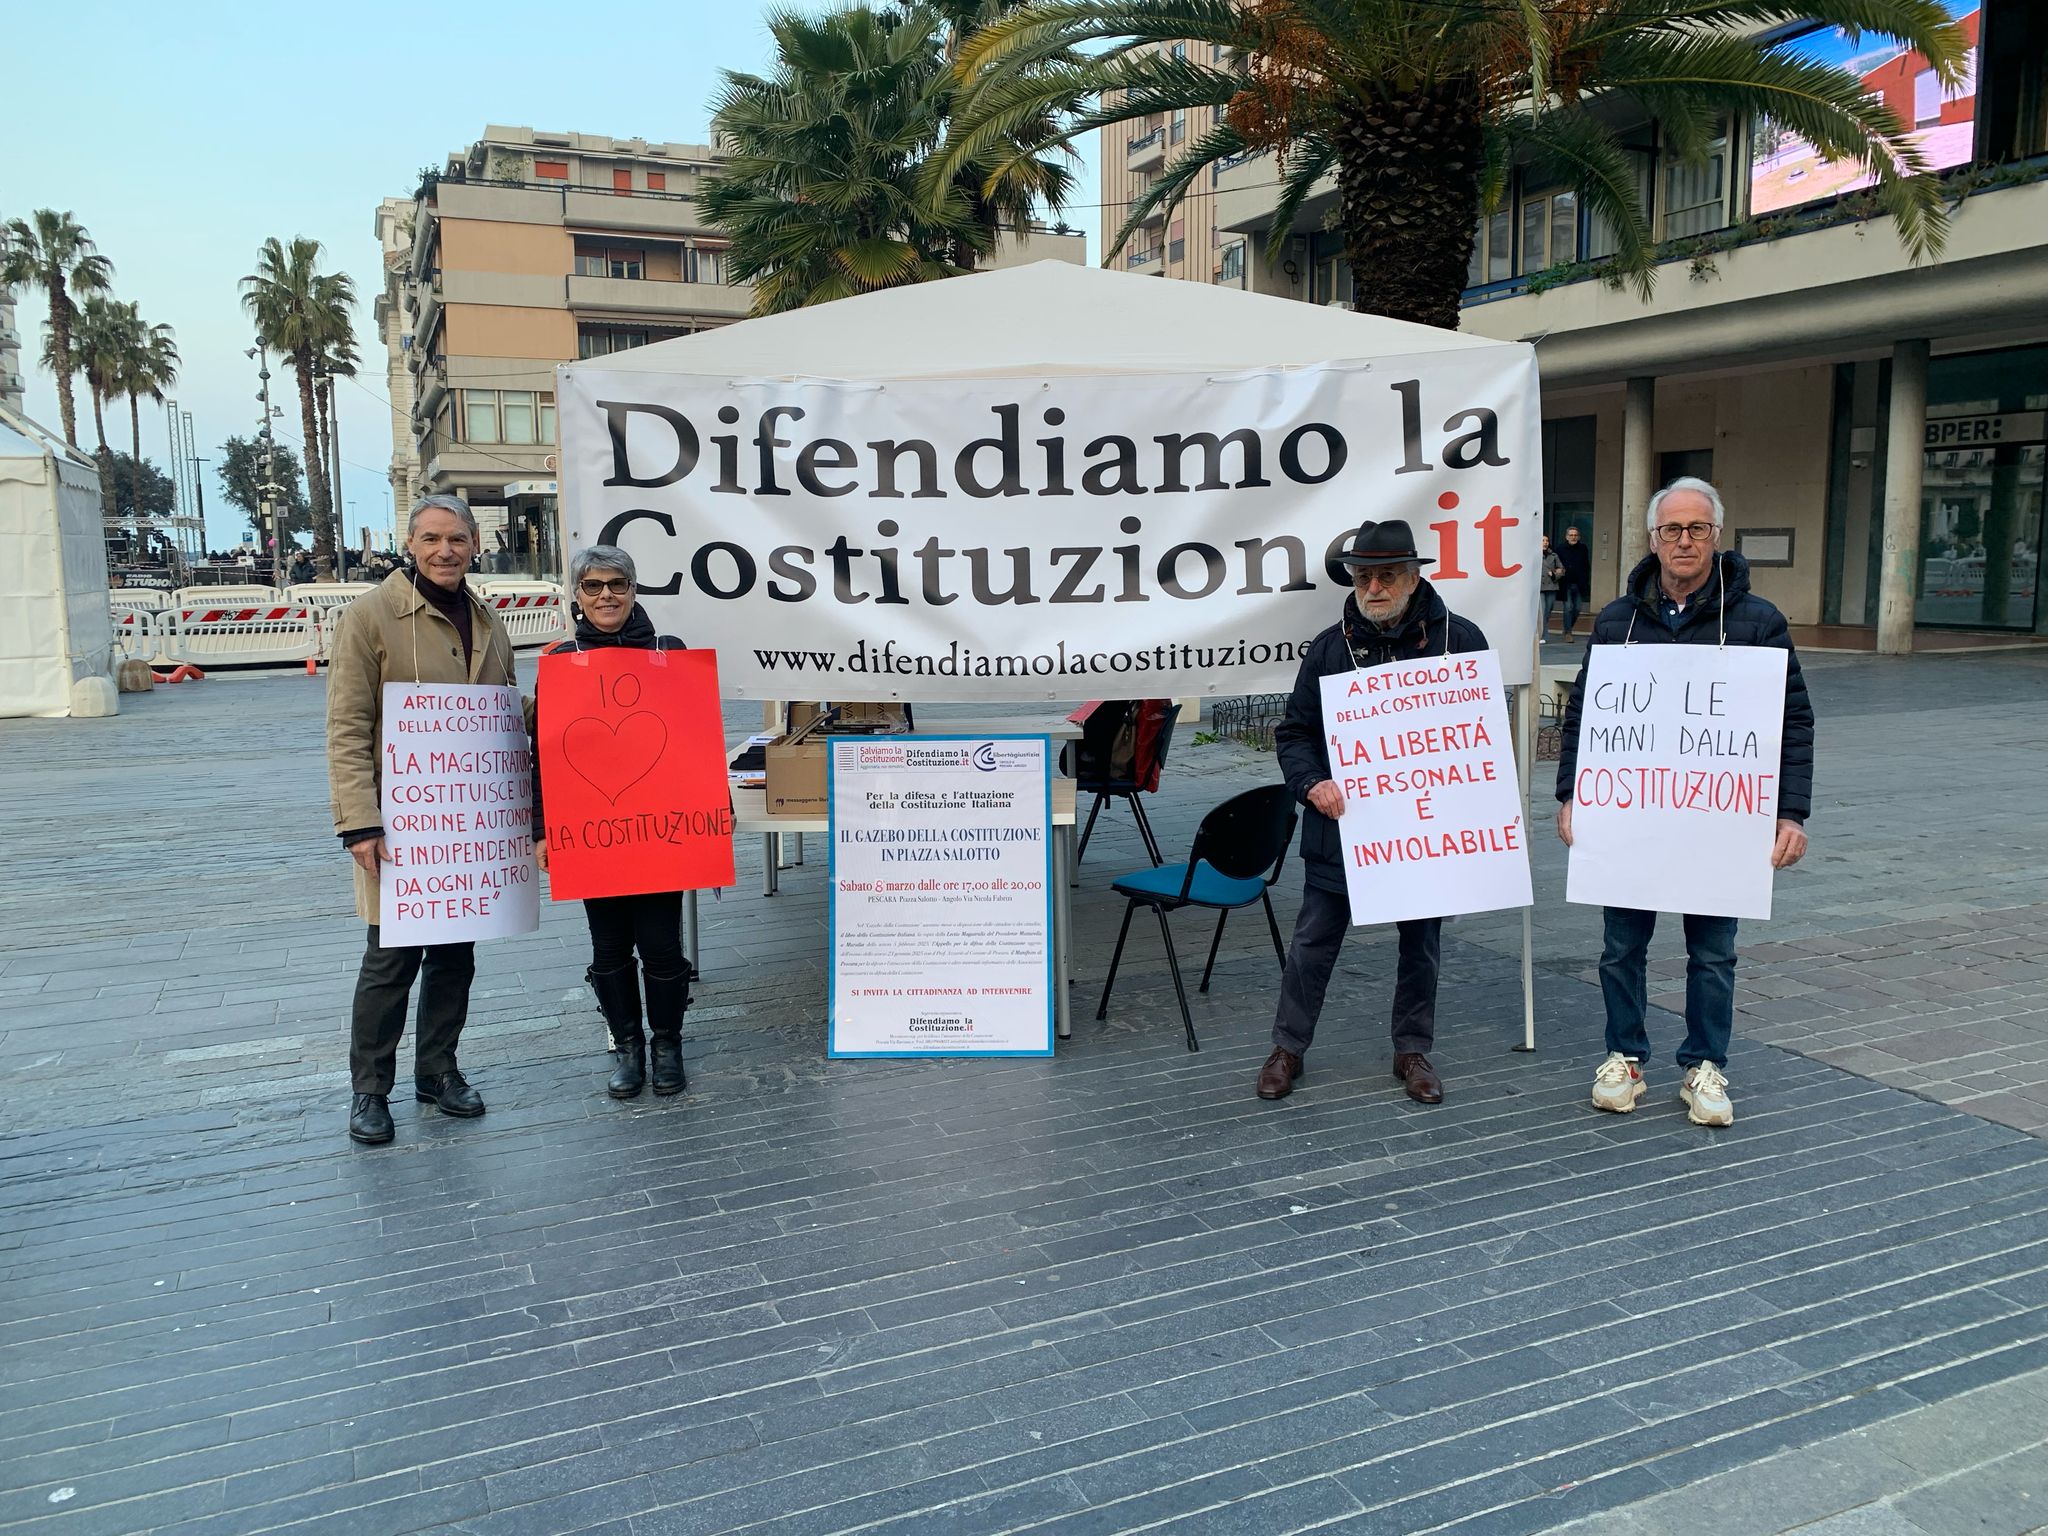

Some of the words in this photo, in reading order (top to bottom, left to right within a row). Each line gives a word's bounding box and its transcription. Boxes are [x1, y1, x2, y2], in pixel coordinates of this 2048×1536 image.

[595, 399, 1348, 498] Difendiamo
[1390, 379, 1512, 475] la
[1347, 667, 1450, 698] ARTICOLO
[1455, 659, 1478, 681] 13
[403, 695, 487, 711] ARTICOLO
[493, 692, 511, 711] 104
[1595, 672, 1658, 714] GIÙ
[1685, 681, 1727, 717] LE
[1336, 705, 1379, 723] DELLA
[1381, 687, 1491, 715] COSTITUZIONE
[398, 720, 442, 733] DELLA
[446, 715, 526, 734] COSTITUZIONE
[1590, 723, 1656, 753] MANI
[1680, 725, 1758, 758] DALLA
[860, 746, 893, 755] Salviamo
[895, 746, 902, 755] la
[860, 755, 904, 763] Costituzione
[906, 749, 958, 758] Difendiamo
[961, 749, 969, 757] la
[906, 758, 969, 767] Costituzione.it
[1345, 761, 1497, 799] PERSONALE
[392, 781, 514, 804] COSTITUISCE
[866, 792, 884, 801] Per
[889, 791, 899, 800] la
[905, 791, 936, 800] difesa
[953, 791, 1015, 800] l'attuazione
[1577, 768, 1774, 817] COSTITUZIONE
[869, 801, 895, 810] della
[900, 800, 966, 809] Costituzione
[972, 800, 1011, 808] Italiana
[392, 813, 467, 832] ORDINE
[549, 825, 574, 852] LA
[583, 807, 731, 849] COSTITUZIONE
[840, 830, 853, 843] IL
[855, 829, 905, 843] GAZEBO
[907, 829, 949, 843] DELLA
[950, 828, 1041, 842] COSTITUZIONE
[394, 847, 404, 867] E
[410, 835, 532, 865] INDIPENDENTE
[881, 848, 895, 861] IN
[897, 848, 941, 862] PIAZZA
[943, 847, 1000, 861] SALOTTO
[396, 877, 423, 897] DA
[427, 873, 473, 894] OGNI
[480, 865, 529, 888] ALTRO
[840, 879, 873, 892] Sabato
[875, 880, 884, 893] 8
[886, 881, 916, 891] marzo
[918, 879, 941, 891] dalle
[943, 881, 960, 891] ore
[962, 881, 989, 893] 17,00
[991, 879, 1008, 890] alle
[1010, 880, 1042, 892] 20,00
[867, 895, 897, 903] PESCARA
[899, 895, 917, 903] Piazza
[917, 895, 937, 903] Salotto
[941, 895, 963, 903] Angolo
[863, 988, 889, 996] INVITA
[893, 988, 903, 996] LA
[907, 988, 962, 996] CITTADINANZA
[910, 1017, 960, 1025] Difendiamo
